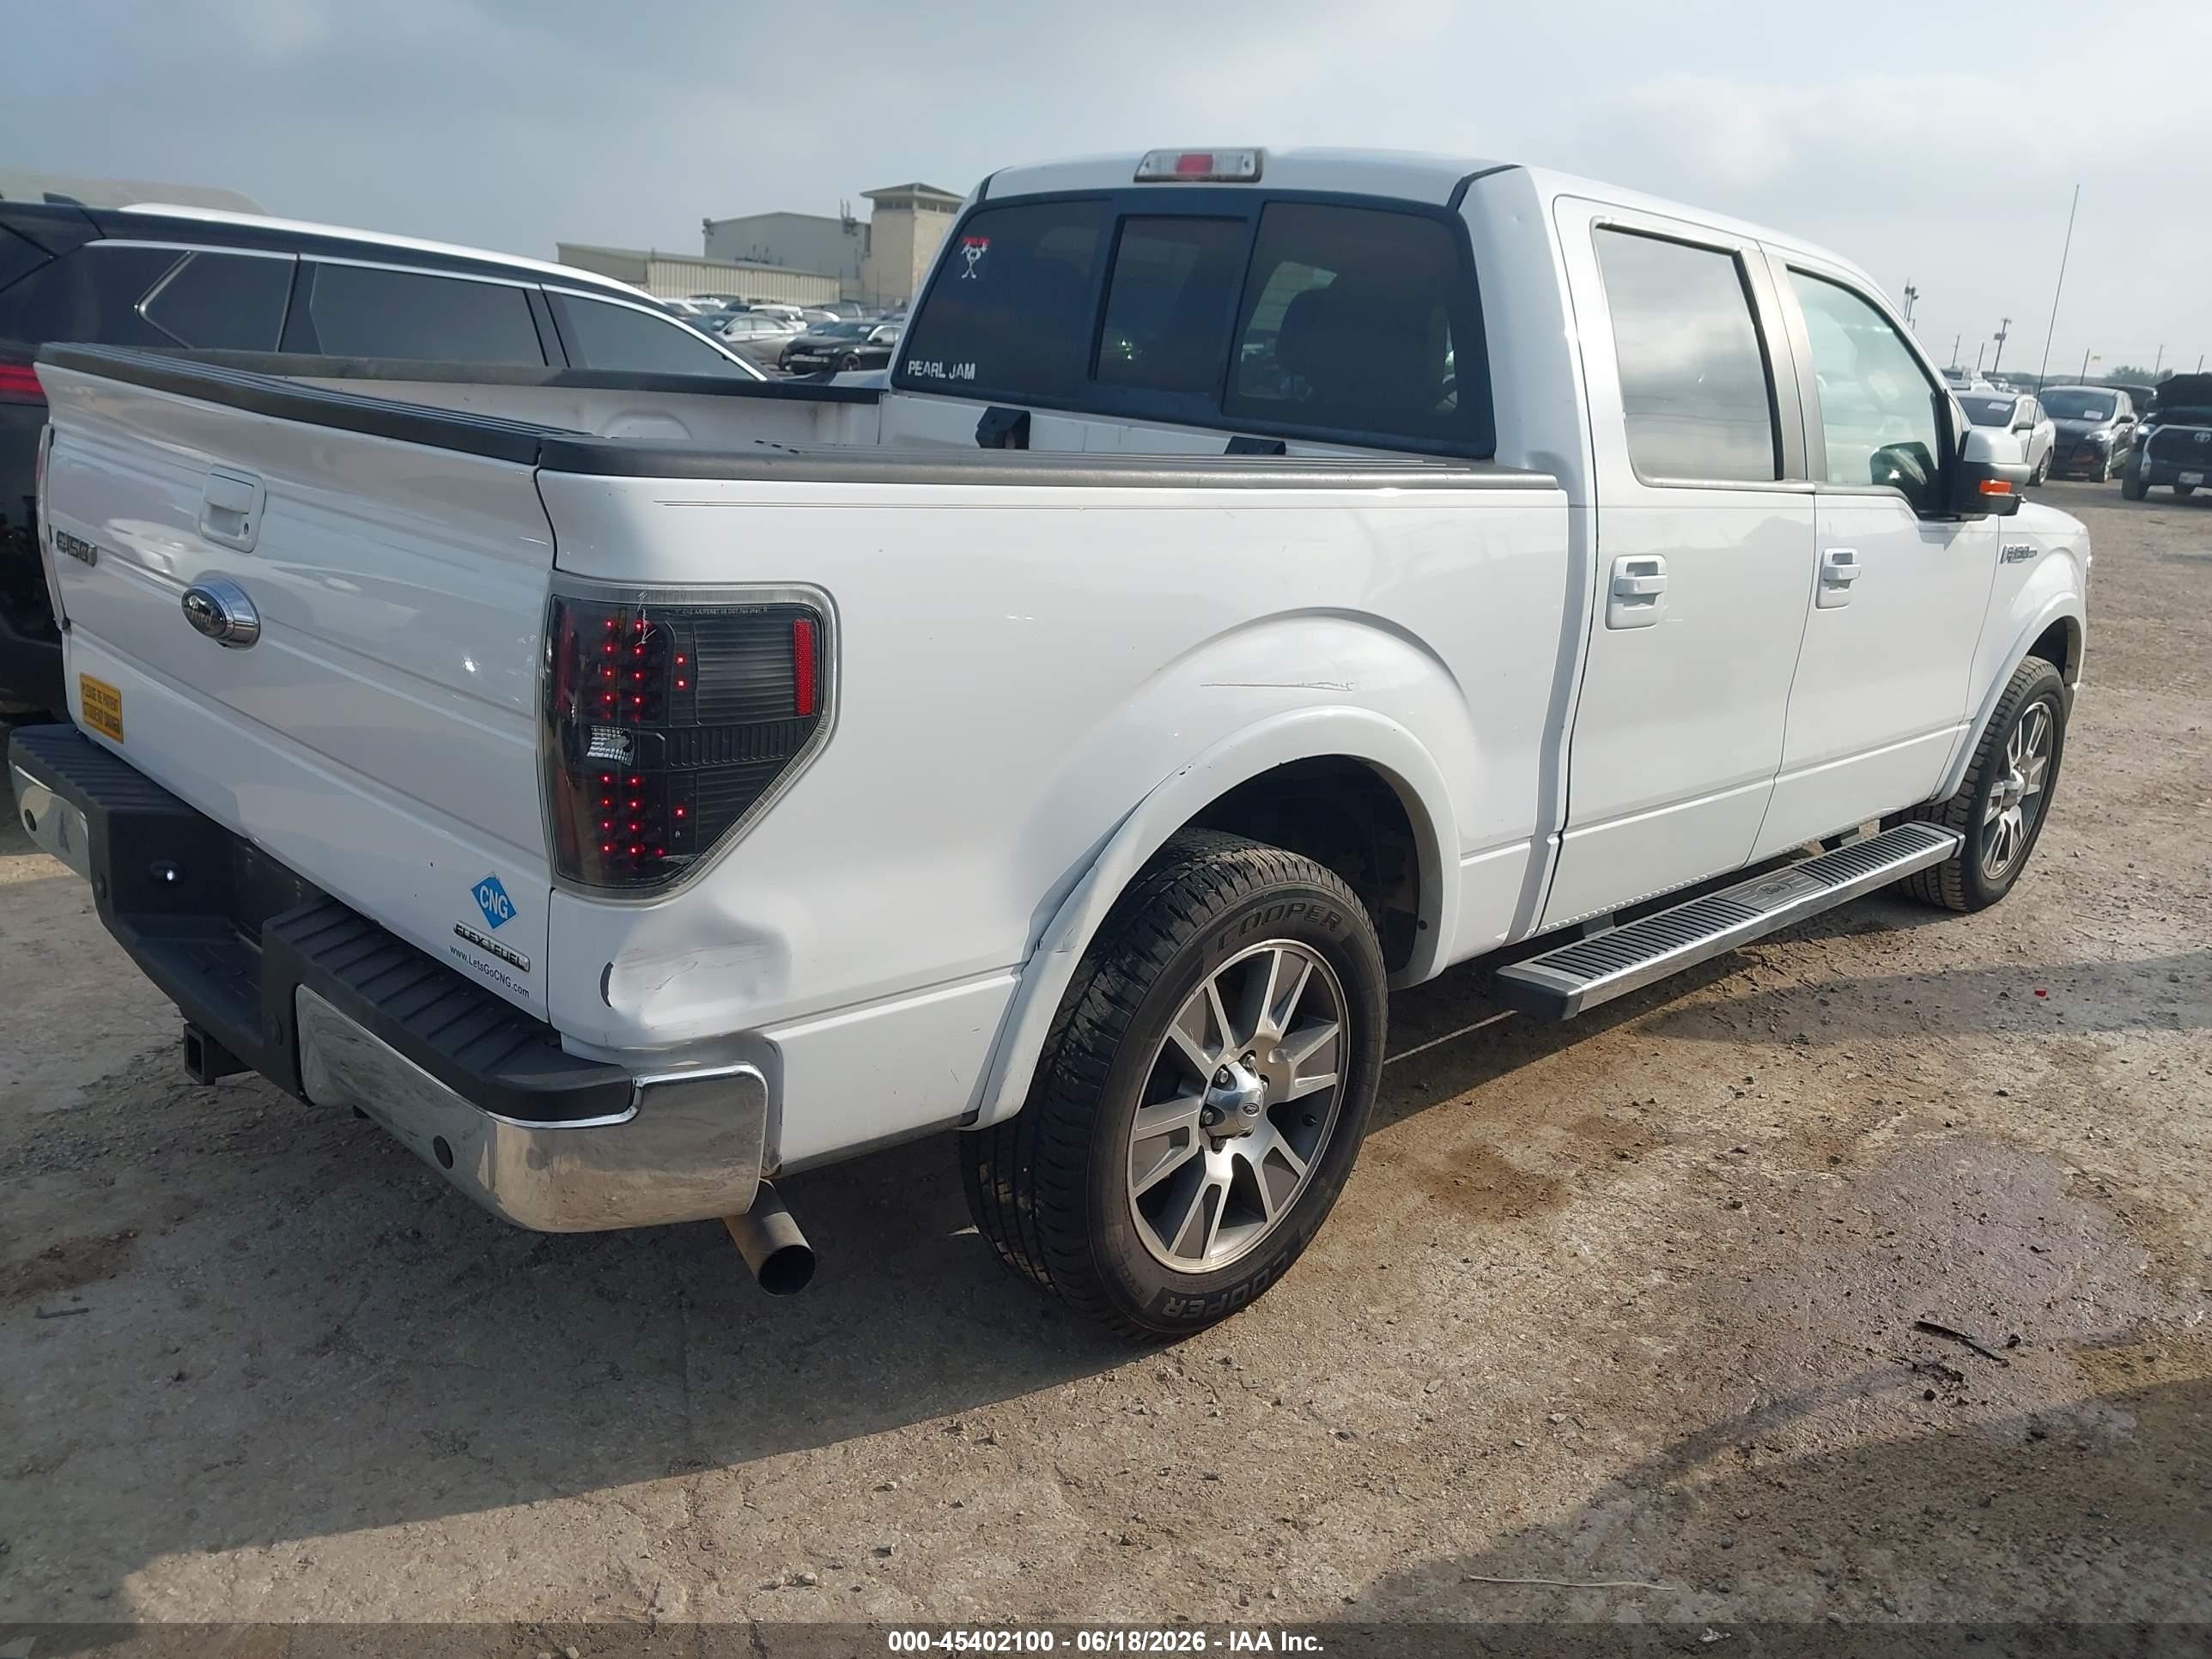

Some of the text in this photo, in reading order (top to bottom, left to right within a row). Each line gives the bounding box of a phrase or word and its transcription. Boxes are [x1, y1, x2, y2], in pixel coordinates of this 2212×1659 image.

[908, 360, 975, 380] PEARL JAM
[479, 884, 508, 920] CNG
[1217, 902, 1343, 953] COOPER
[449, 945, 530, 1000] www.LetsGoCNG.com
